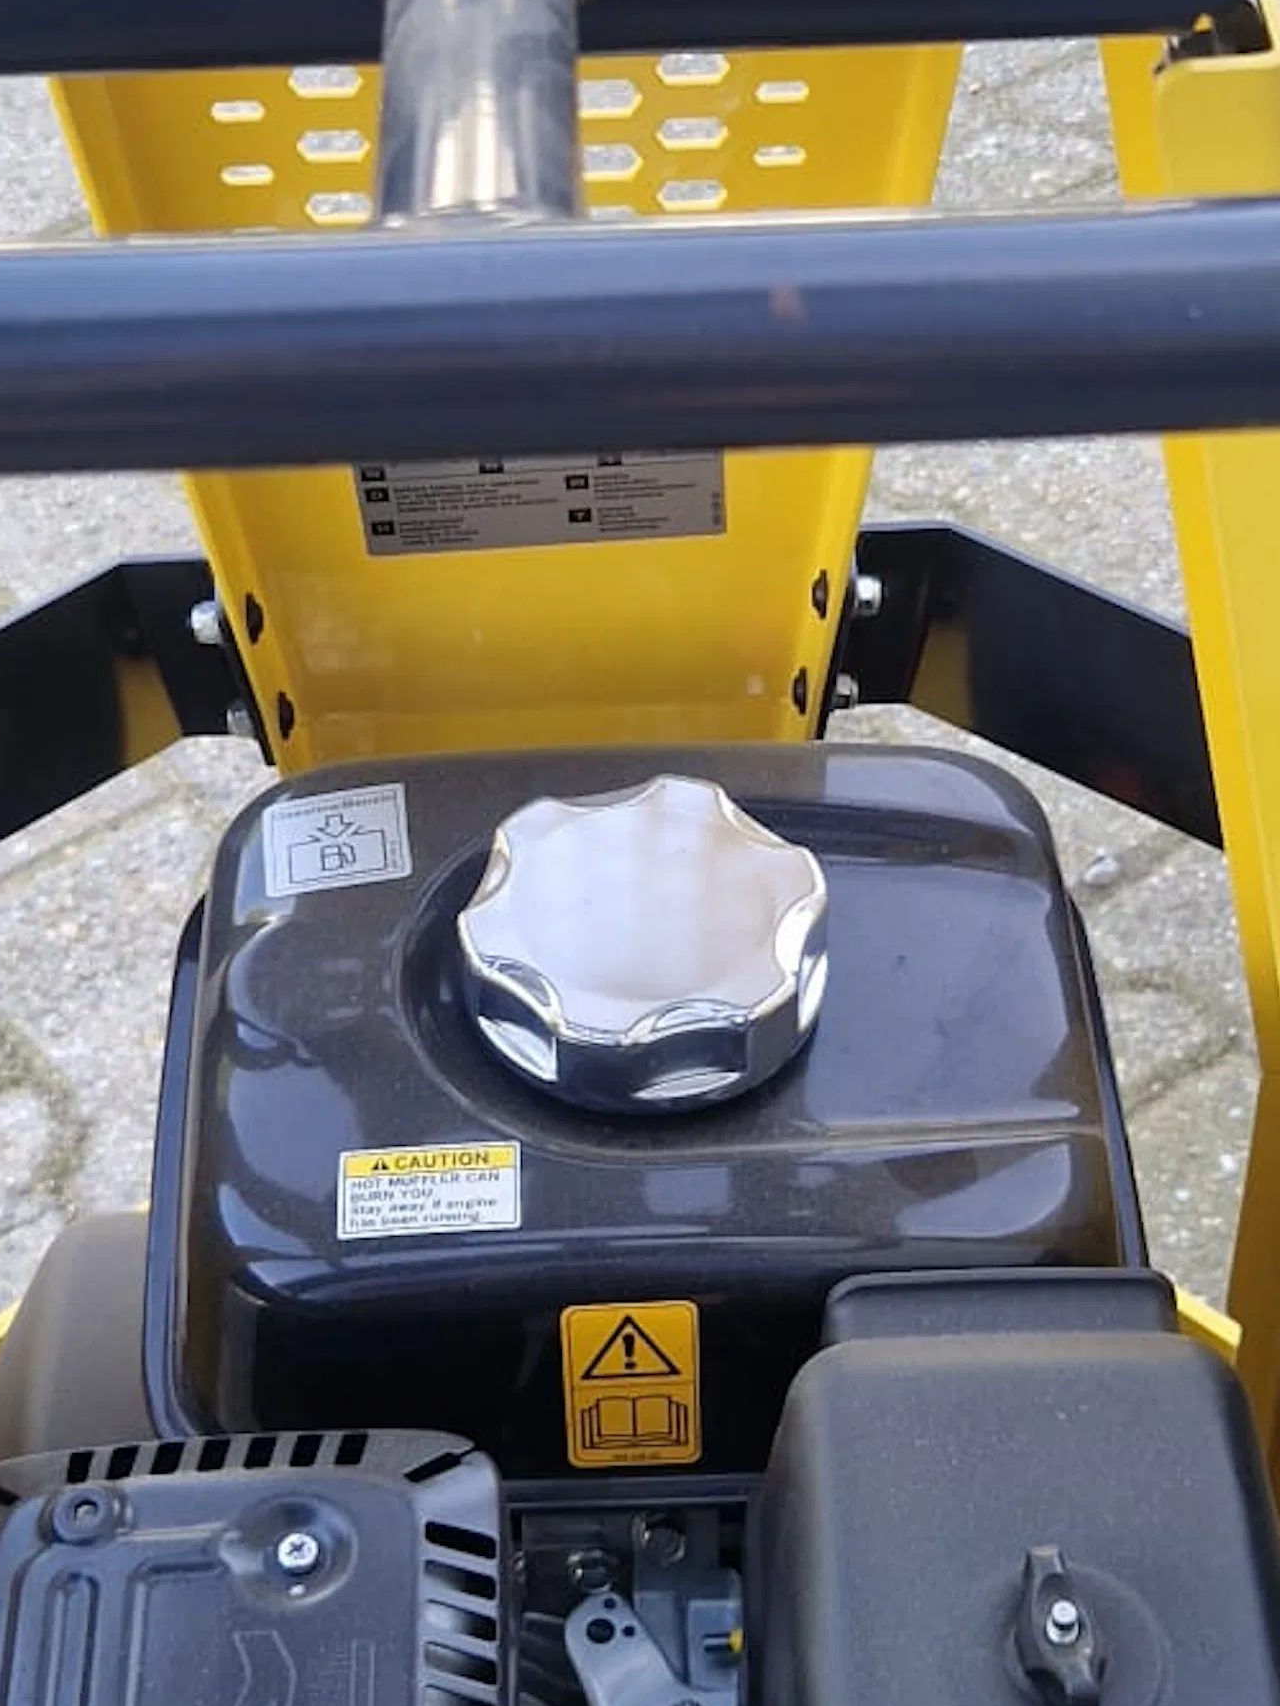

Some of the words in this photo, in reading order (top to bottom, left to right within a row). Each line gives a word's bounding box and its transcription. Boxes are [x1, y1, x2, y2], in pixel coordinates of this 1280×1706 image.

[394, 1151, 490, 1171] CAUTION
[351, 1178, 382, 1191] HOT
[388, 1172, 461, 1188] MUFFLER
[465, 1170, 501, 1183] CAN
[350, 1190, 395, 1203] BURN
